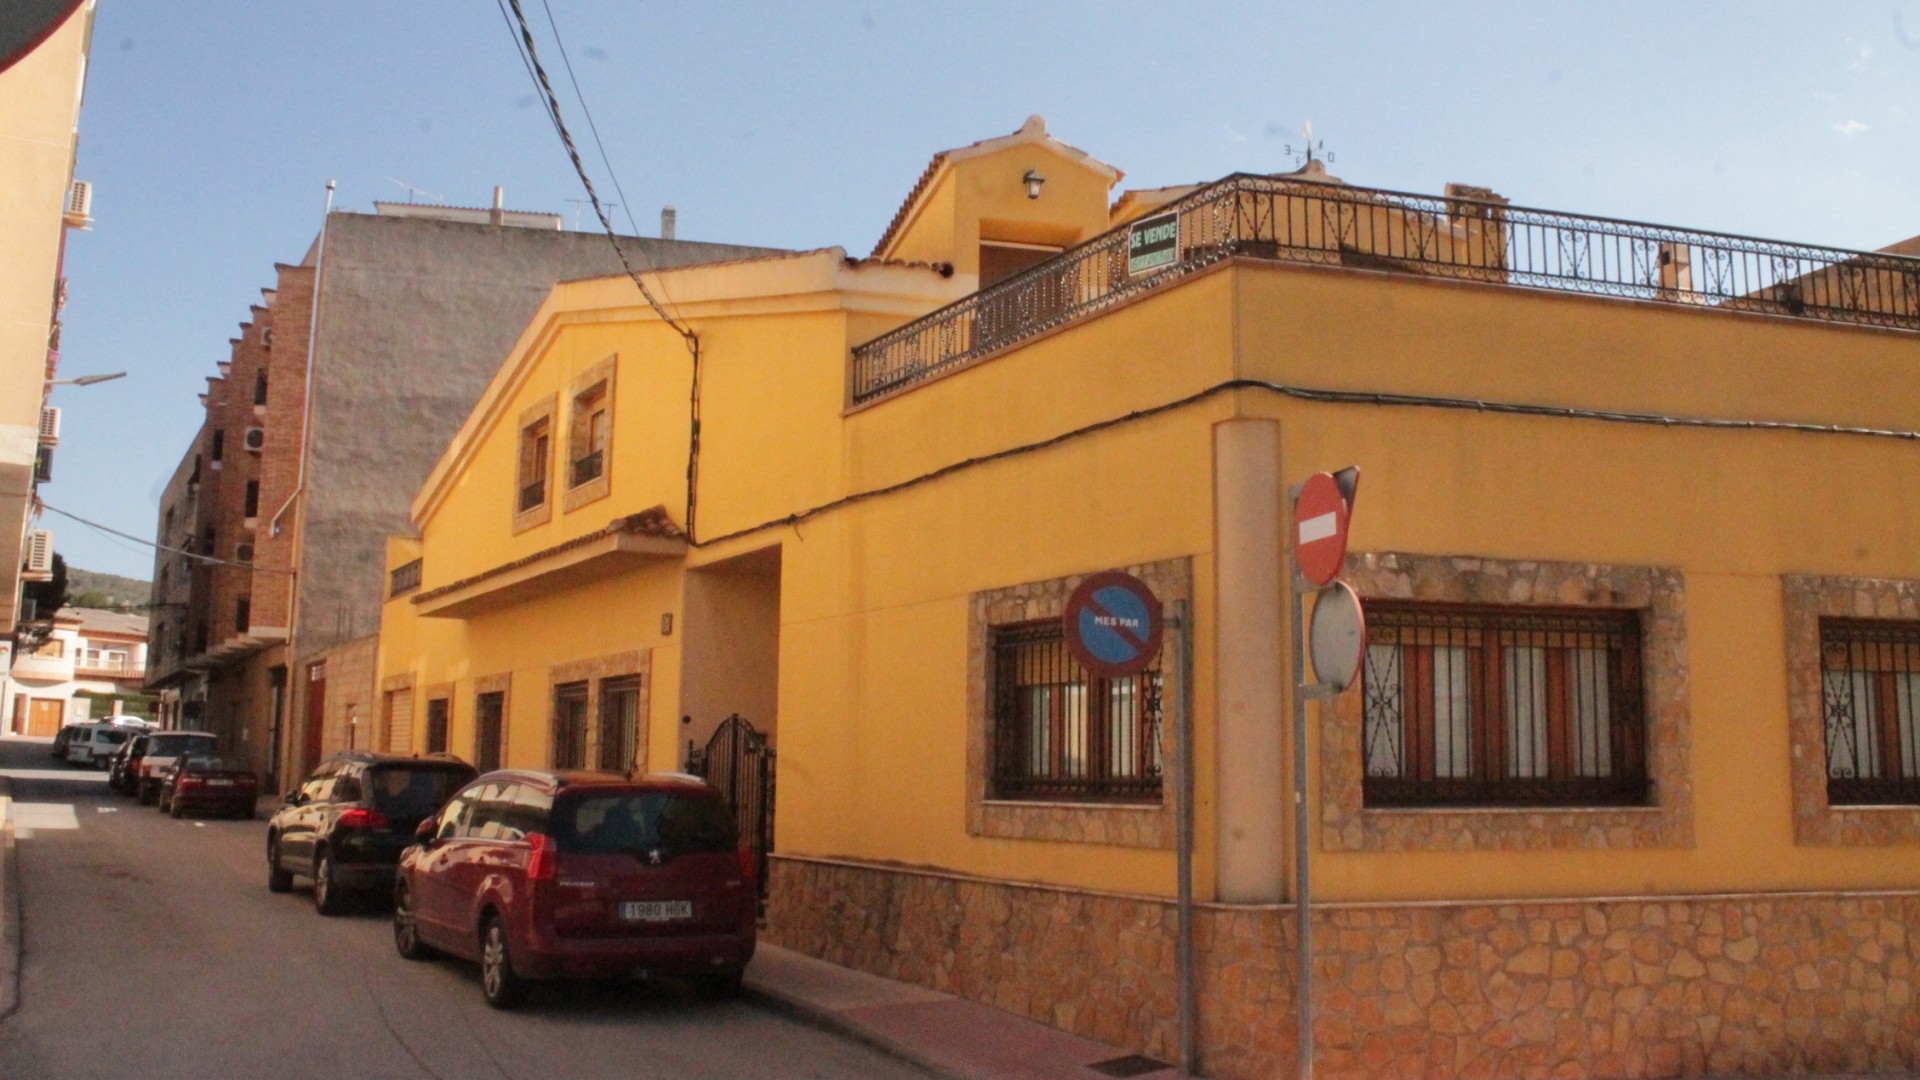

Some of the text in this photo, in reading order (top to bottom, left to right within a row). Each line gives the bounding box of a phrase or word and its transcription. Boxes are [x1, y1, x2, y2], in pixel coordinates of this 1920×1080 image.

[1131, 221, 1177, 249] SE VENDE
[1094, 616, 1139, 627] MES PAR
[631, 903, 661, 917] 1980
